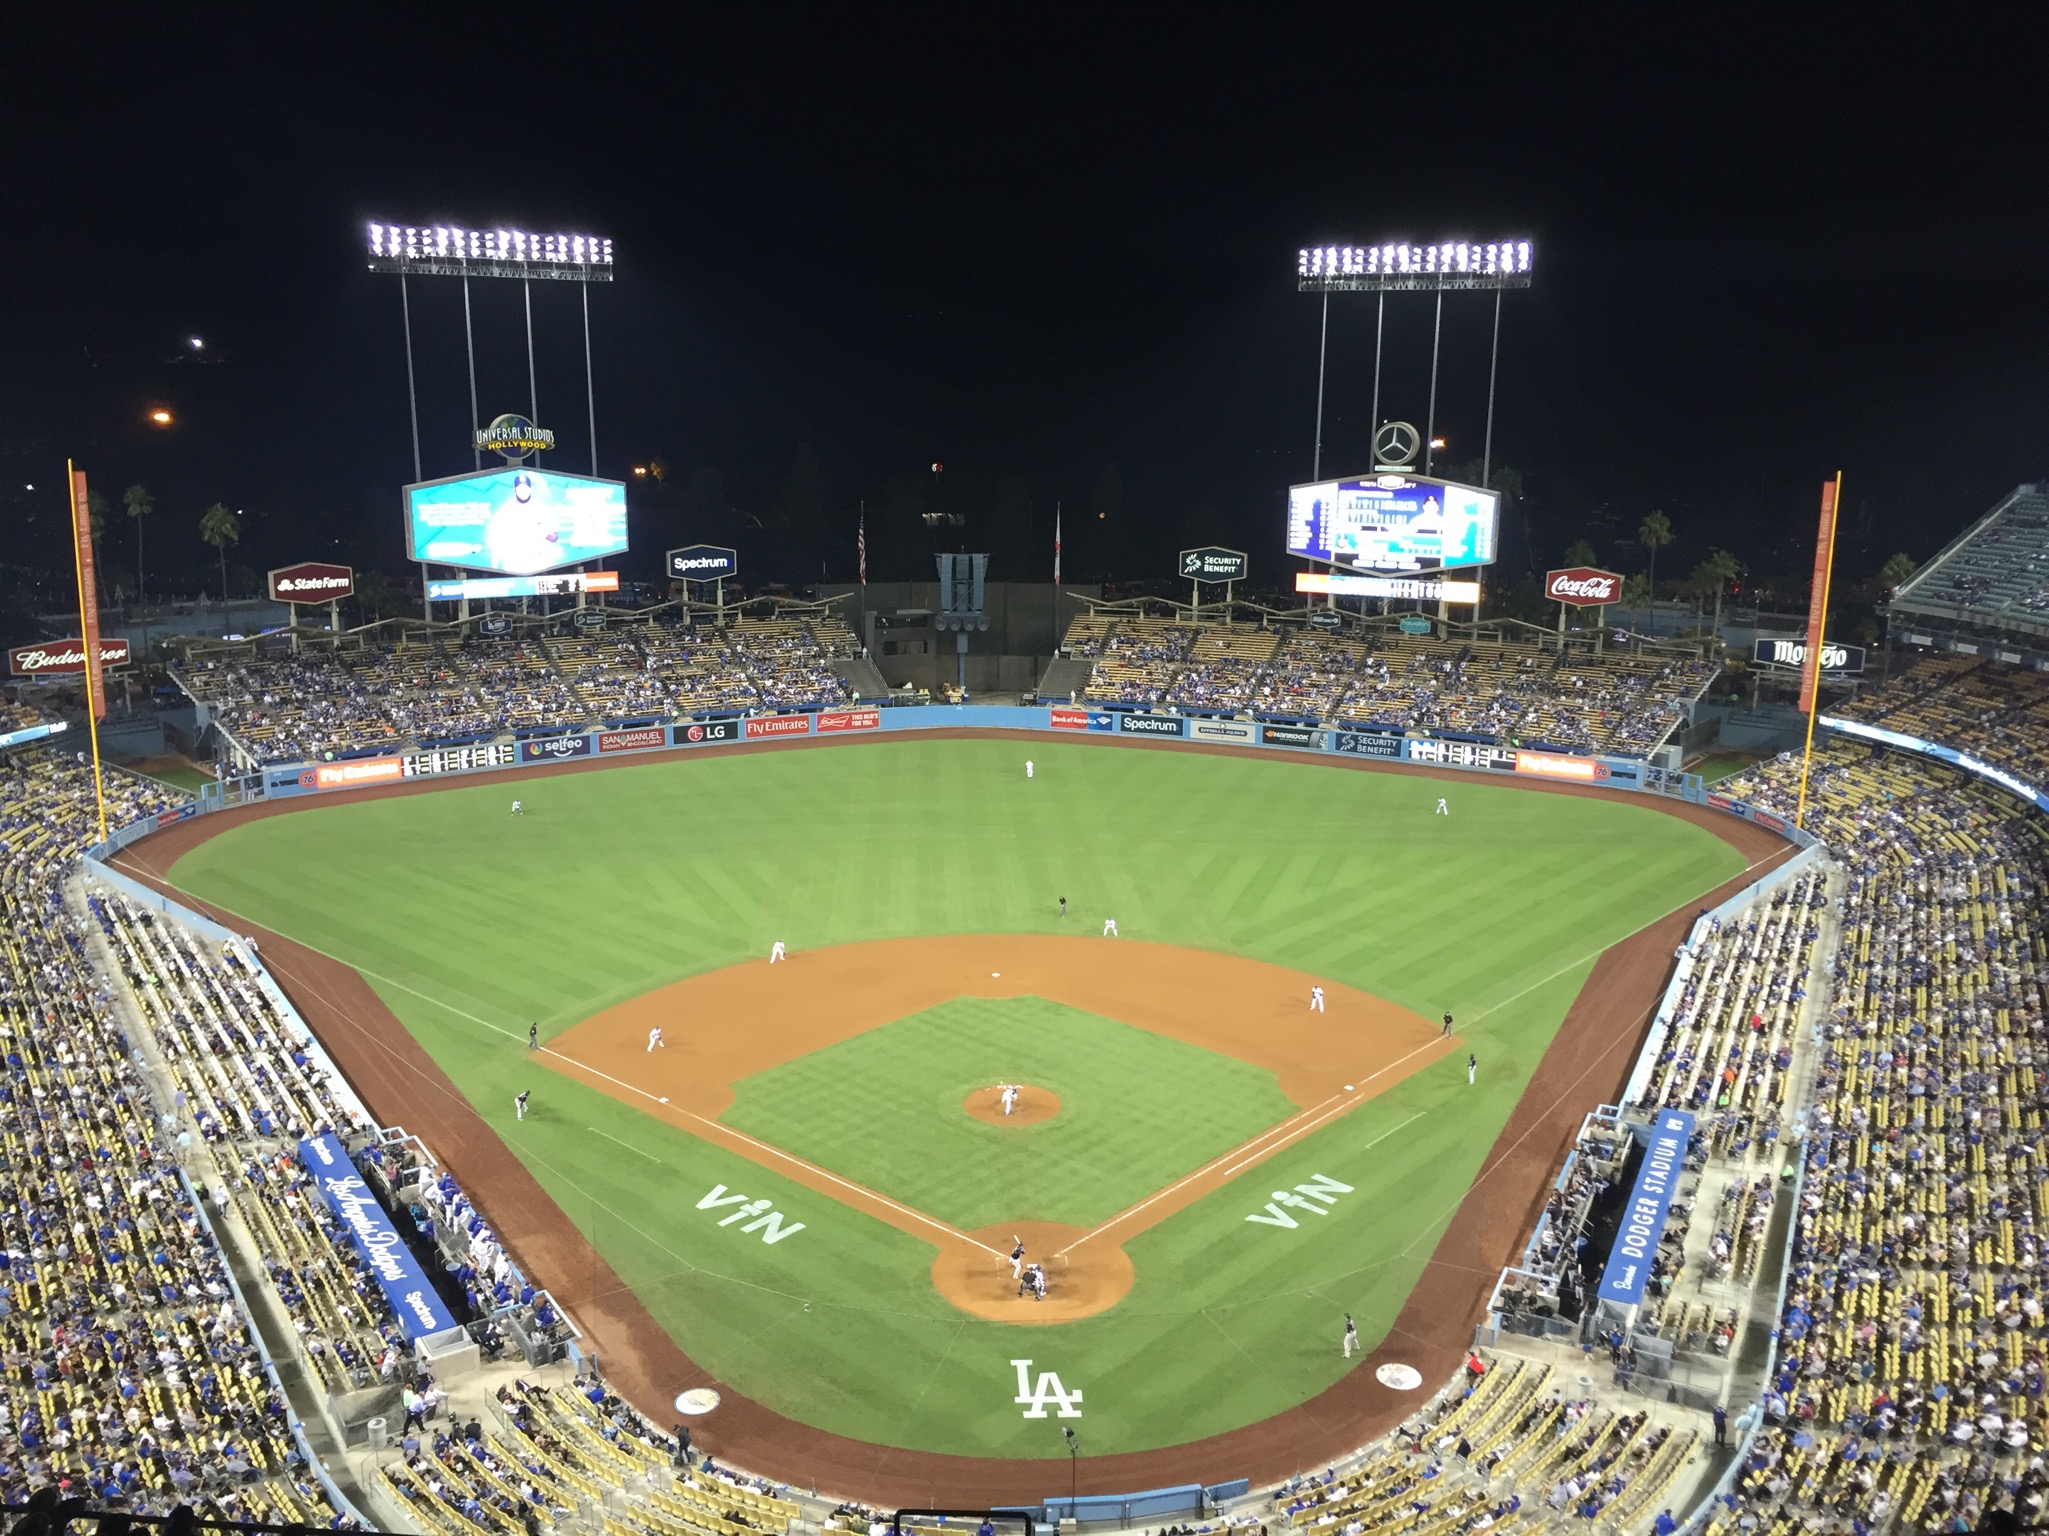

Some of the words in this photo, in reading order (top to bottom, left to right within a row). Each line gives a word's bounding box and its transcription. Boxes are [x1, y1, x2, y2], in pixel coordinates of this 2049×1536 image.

[476, 426, 522, 444] UNIVERSAL
[524, 426, 555, 444] STUDIOS
[488, 441, 547, 450] HOLLYWOOD
[674, 557, 728, 571] Spectrum
[1204, 555, 1242, 565] SECURITY
[1203, 564, 1237, 573] BENEFIT
[1551, 575, 1616, 598] Coca-Cola
[747, 722, 764, 735] Fly
[765, 719, 809, 732] Emirates
[1052, 715, 1067, 723] Bank
[1073, 716, 1098, 725] America
[1123, 717, 1177, 731] Spectrum
[602, 735, 620, 745] SAN
[627, 731, 662, 741] MANUEL
[706, 725, 726, 739] LG
[1357, 735, 1398, 748] SECURITY
[1357, 744, 1392, 755] BENEFIT
[1597, 768, 1608, 776] 76
[303, 775, 314, 784] 76
[309, 1137, 335, 1166] Spectrum
[1621, 1197, 1660, 1259] DODGER
[1643, 1137, 1679, 1194] STADIUM
[336, 1193, 380, 1237] Angeles
[359, 1231, 408, 1282] Dodgers
[405, 1290, 438, 1330] Spectrum
[1010, 1359, 1083, 1419] LA
